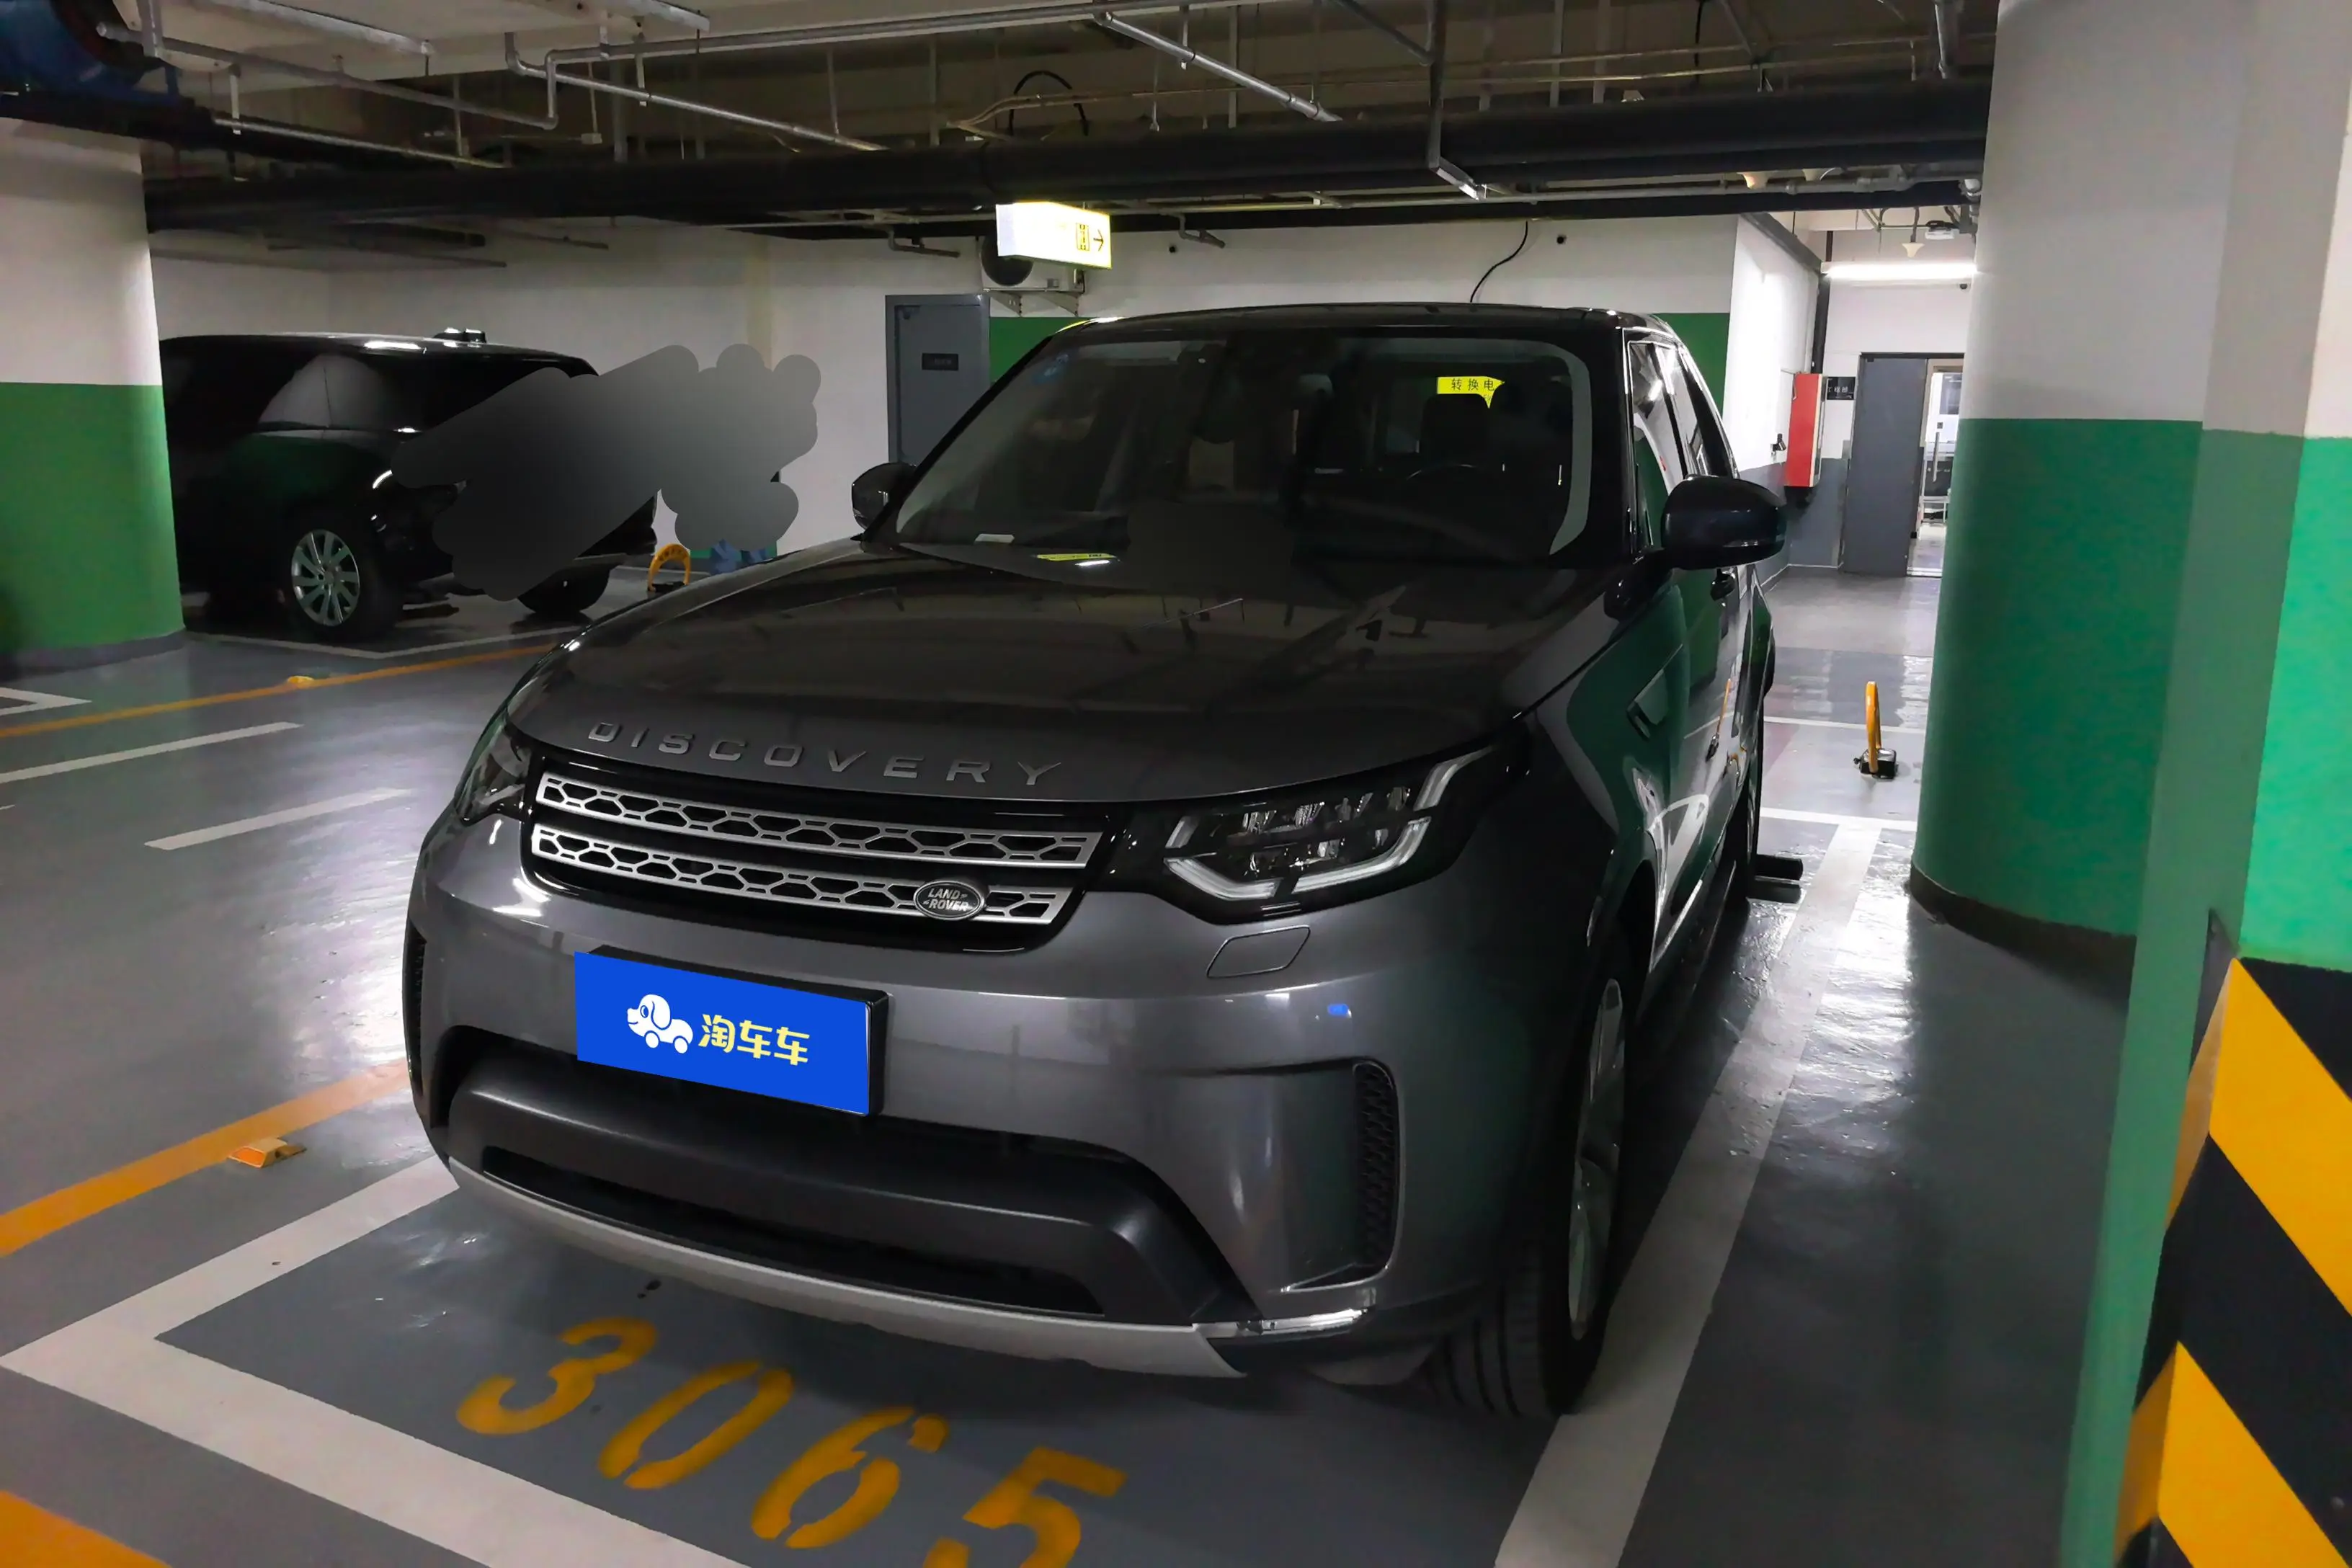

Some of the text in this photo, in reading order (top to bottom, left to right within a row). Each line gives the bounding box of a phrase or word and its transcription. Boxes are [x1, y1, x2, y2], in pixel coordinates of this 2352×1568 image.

[1451, 378, 1495, 391] 转换电
[588, 721, 1061, 785] DISCOVERY
[927, 888, 961, 900] LAND
[929, 898, 971, 912] ROVER
[455, 1317, 1128, 1568] 3065
